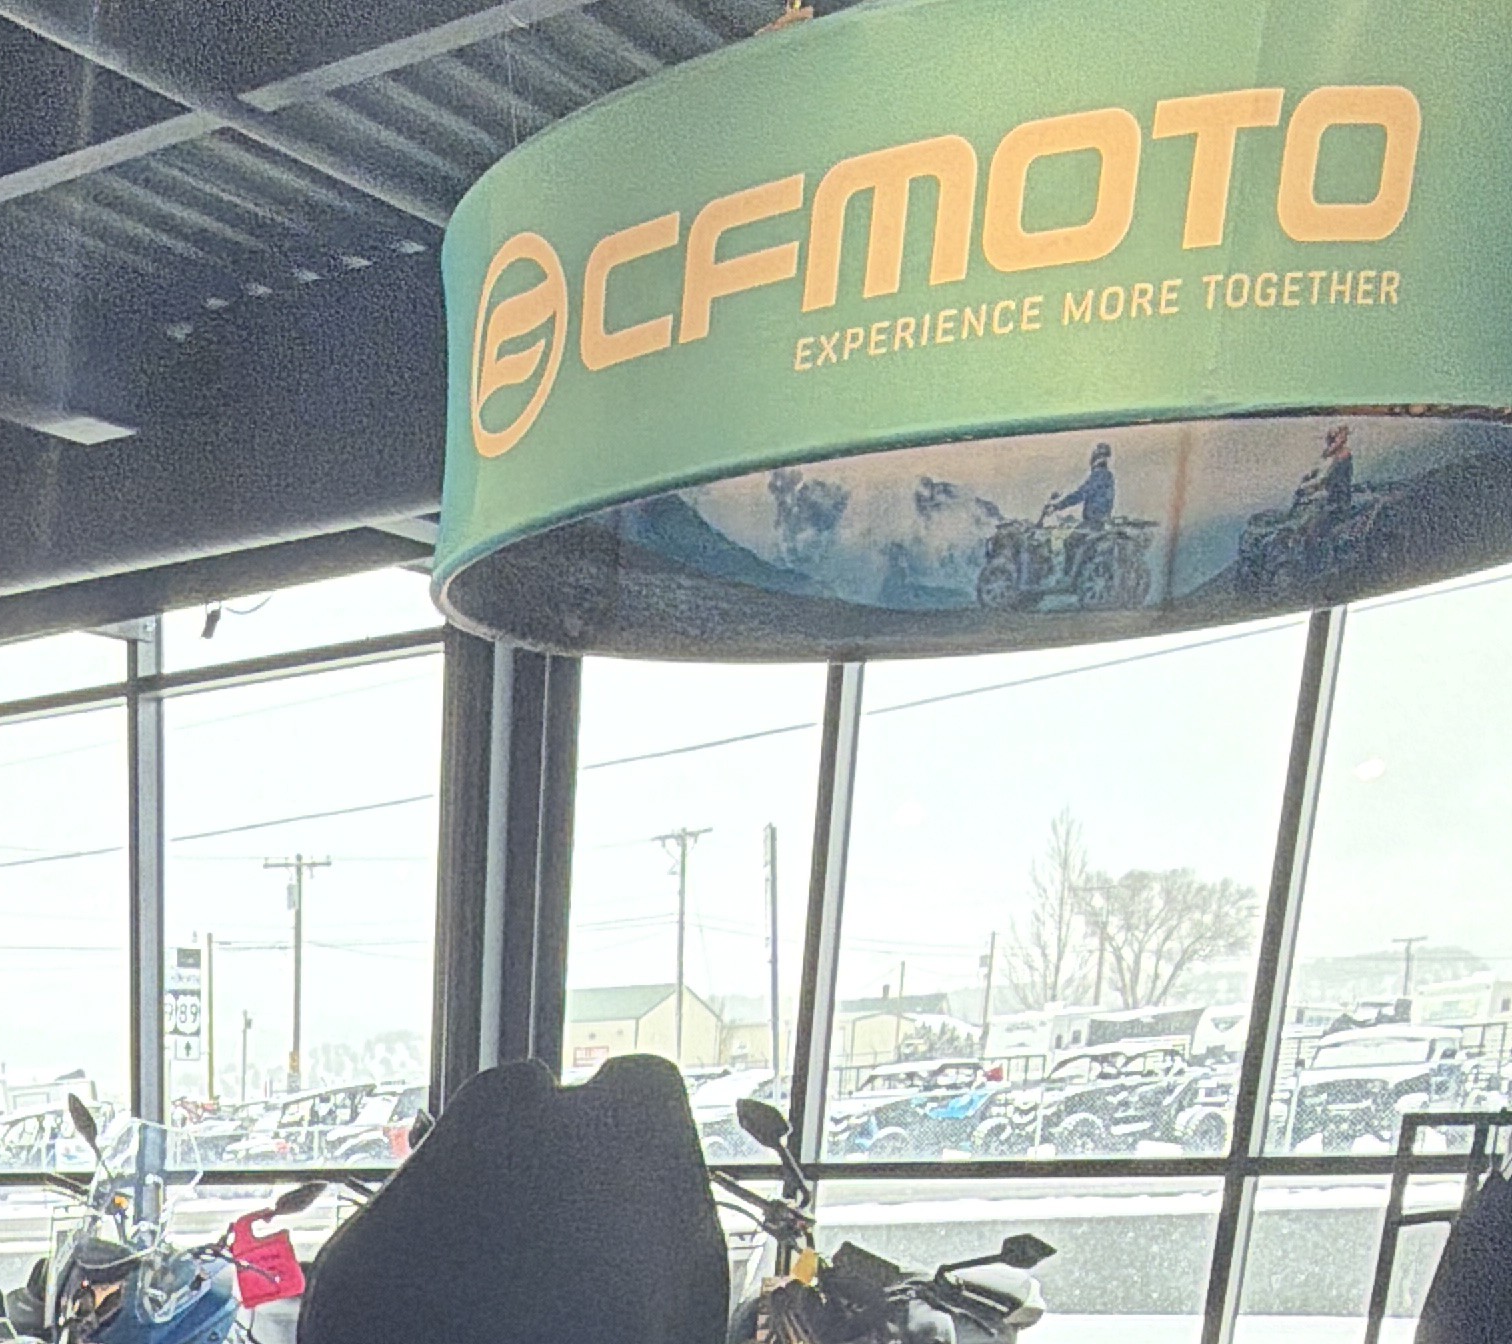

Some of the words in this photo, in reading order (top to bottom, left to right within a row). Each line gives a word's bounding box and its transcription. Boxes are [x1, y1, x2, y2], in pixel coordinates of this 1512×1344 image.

[579, 84, 1422, 372] CFMOTO
[793, 296, 1044, 372] EXPERIENCE
[1061, 277, 1182, 326] MORE
[1203, 270, 1402, 311] TOGETHER
[179, 1003, 199, 1024] 89
